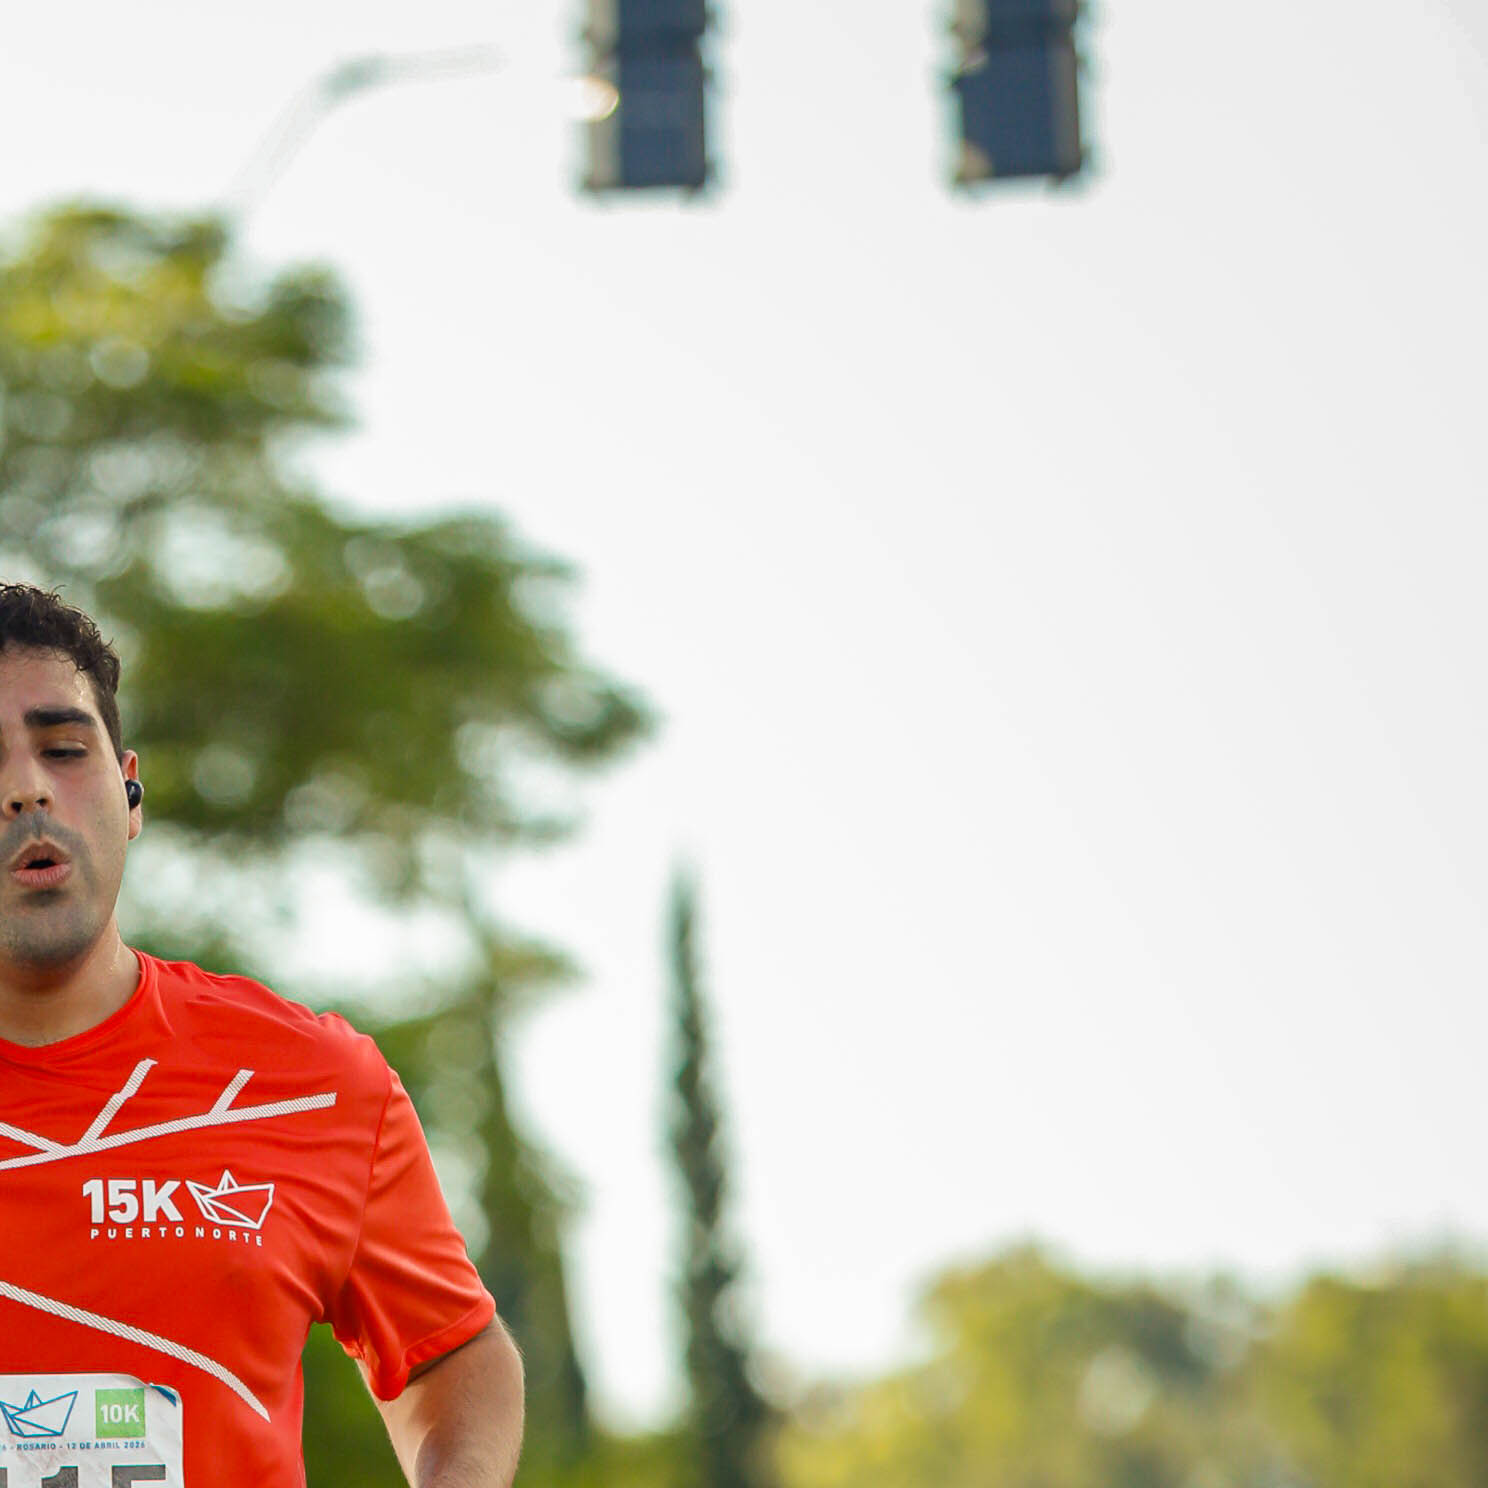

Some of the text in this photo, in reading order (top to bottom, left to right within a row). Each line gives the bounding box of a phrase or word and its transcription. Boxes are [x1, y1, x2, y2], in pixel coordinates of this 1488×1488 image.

[82, 1178, 184, 1224] 15K
[100, 1404, 140, 1424] 10K
[16, 1442, 57, 1450] ROSARIO
[79, 1441, 91, 1449] DE
[94, 1441, 120, 1449] ABRIL
